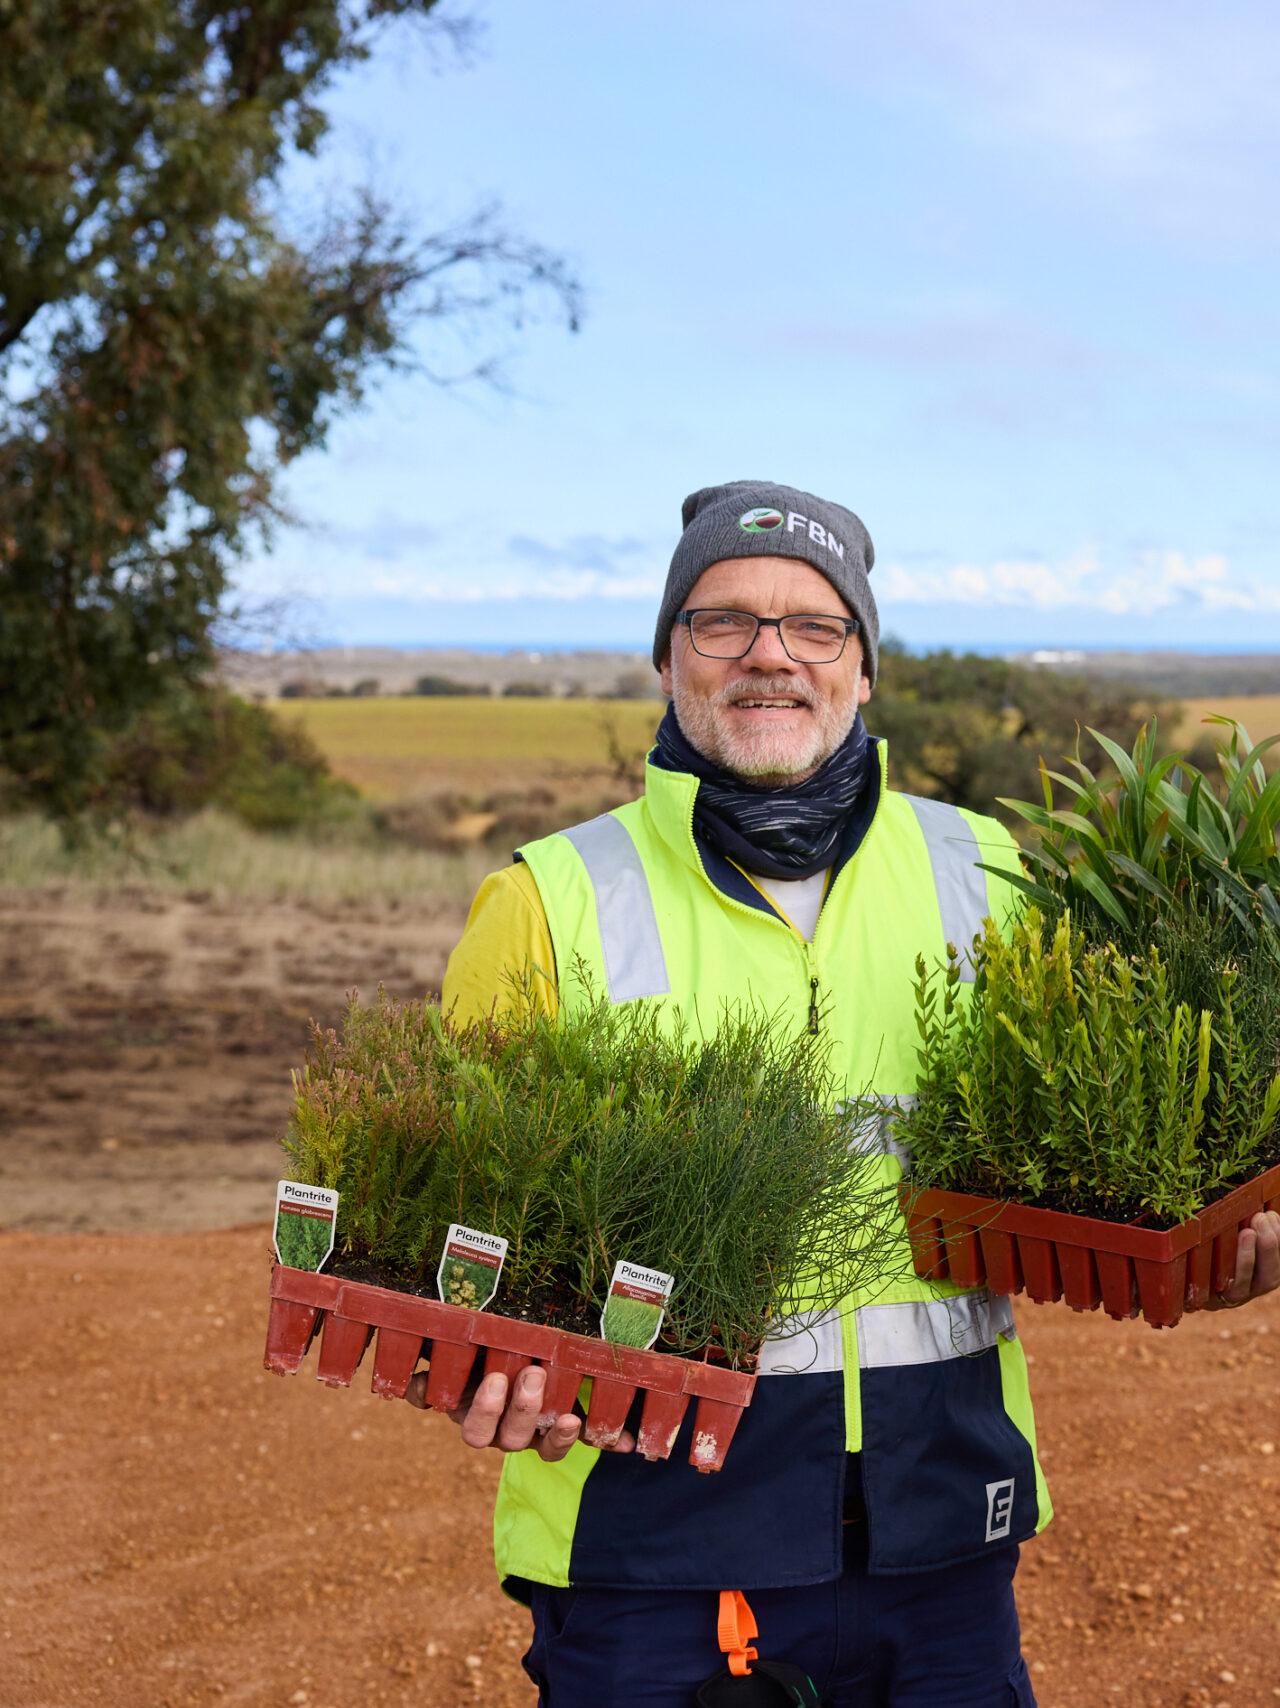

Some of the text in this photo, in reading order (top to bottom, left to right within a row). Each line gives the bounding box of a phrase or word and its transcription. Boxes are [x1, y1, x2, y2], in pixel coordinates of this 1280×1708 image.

[787, 511, 844, 560] FBN
[284, 1185, 332, 1203] Plantrite
[455, 1228, 502, 1250] Plantrite
[621, 1265, 667, 1287] Plantrite
